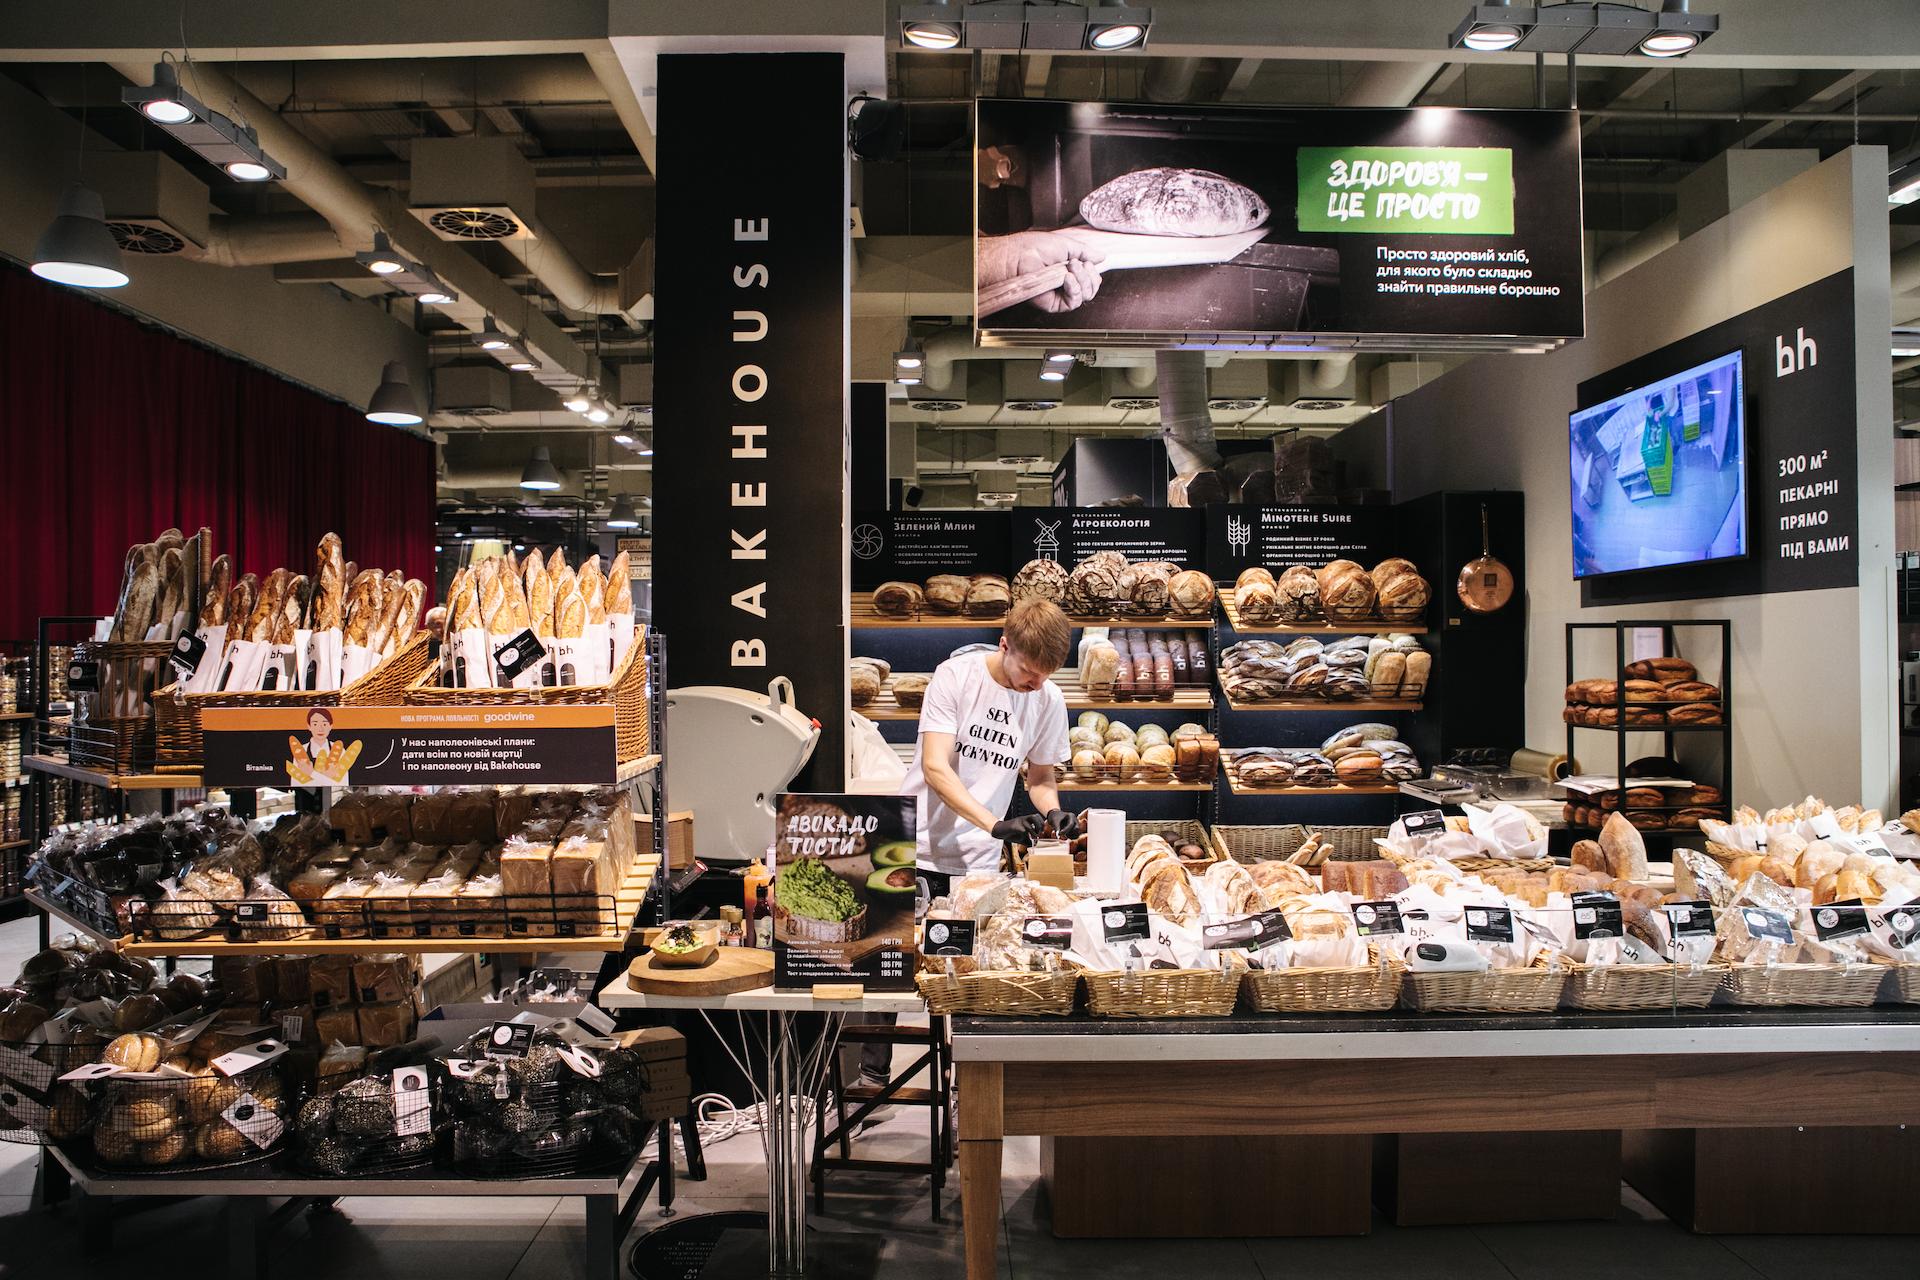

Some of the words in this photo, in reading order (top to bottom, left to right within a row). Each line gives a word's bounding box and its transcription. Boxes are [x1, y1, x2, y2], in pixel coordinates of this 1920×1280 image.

[1327, 192, 1365, 222] ЦЕ
[1376, 191, 1481, 221] ПРОСТО
[1376, 246, 1427, 262] Просто
[1430, 247, 1495, 263] здоровий
[1498, 249, 1529, 265] хліб,
[1376, 266, 1401, 279] для
[1403, 267, 1441, 279] якого
[1443, 265, 1476, 282] було
[1478, 268, 1532, 280] складно
[1377, 280, 1424, 293] знайти
[1427, 283, 1497, 295] правильне
[1500, 284, 1560, 297] борошно
[1775, 327, 1817, 378] bh
[731, 218, 769, 667] BAKEHOUSE
[1778, 455, 1807, 477] 300
[1780, 479, 1839, 503] ПЕКАРНІ
[1780, 510, 1829, 531] ПРЯМО
[1781, 543, 1804, 560] ПІД
[1807, 536, 1849, 556] ВАМИ
[559, 645, 574, 656] bh
[401, 714, 415, 722] НОВА
[416, 714, 445, 722] ПРОГРАМА
[484, 712, 535, 723] goodwine
[986, 707, 1012, 725] SEX
[401, 737, 407, 747] У
[428, 737, 501, 747] наполеонівські
[504, 738, 536, 746] плани:
[969, 724, 1018, 749] GLUTEN
[402, 751, 424, 759] дати
[426, 750, 448, 758] всім
[464, 749, 490, 758] новій
[492, 749, 522, 760] картці
[246, 764, 274, 772] Віталіна
[402, 762, 406, 770] і
[421, 763, 472, 772] наполеону
[474, 761, 489, 771] від
[491, 761, 542, 770] Bakehouse
[787, 815, 879, 836] АВОКАДО
[786, 836, 856, 856] ТОСТИ
[1623, 944, 1639, 961] bh
